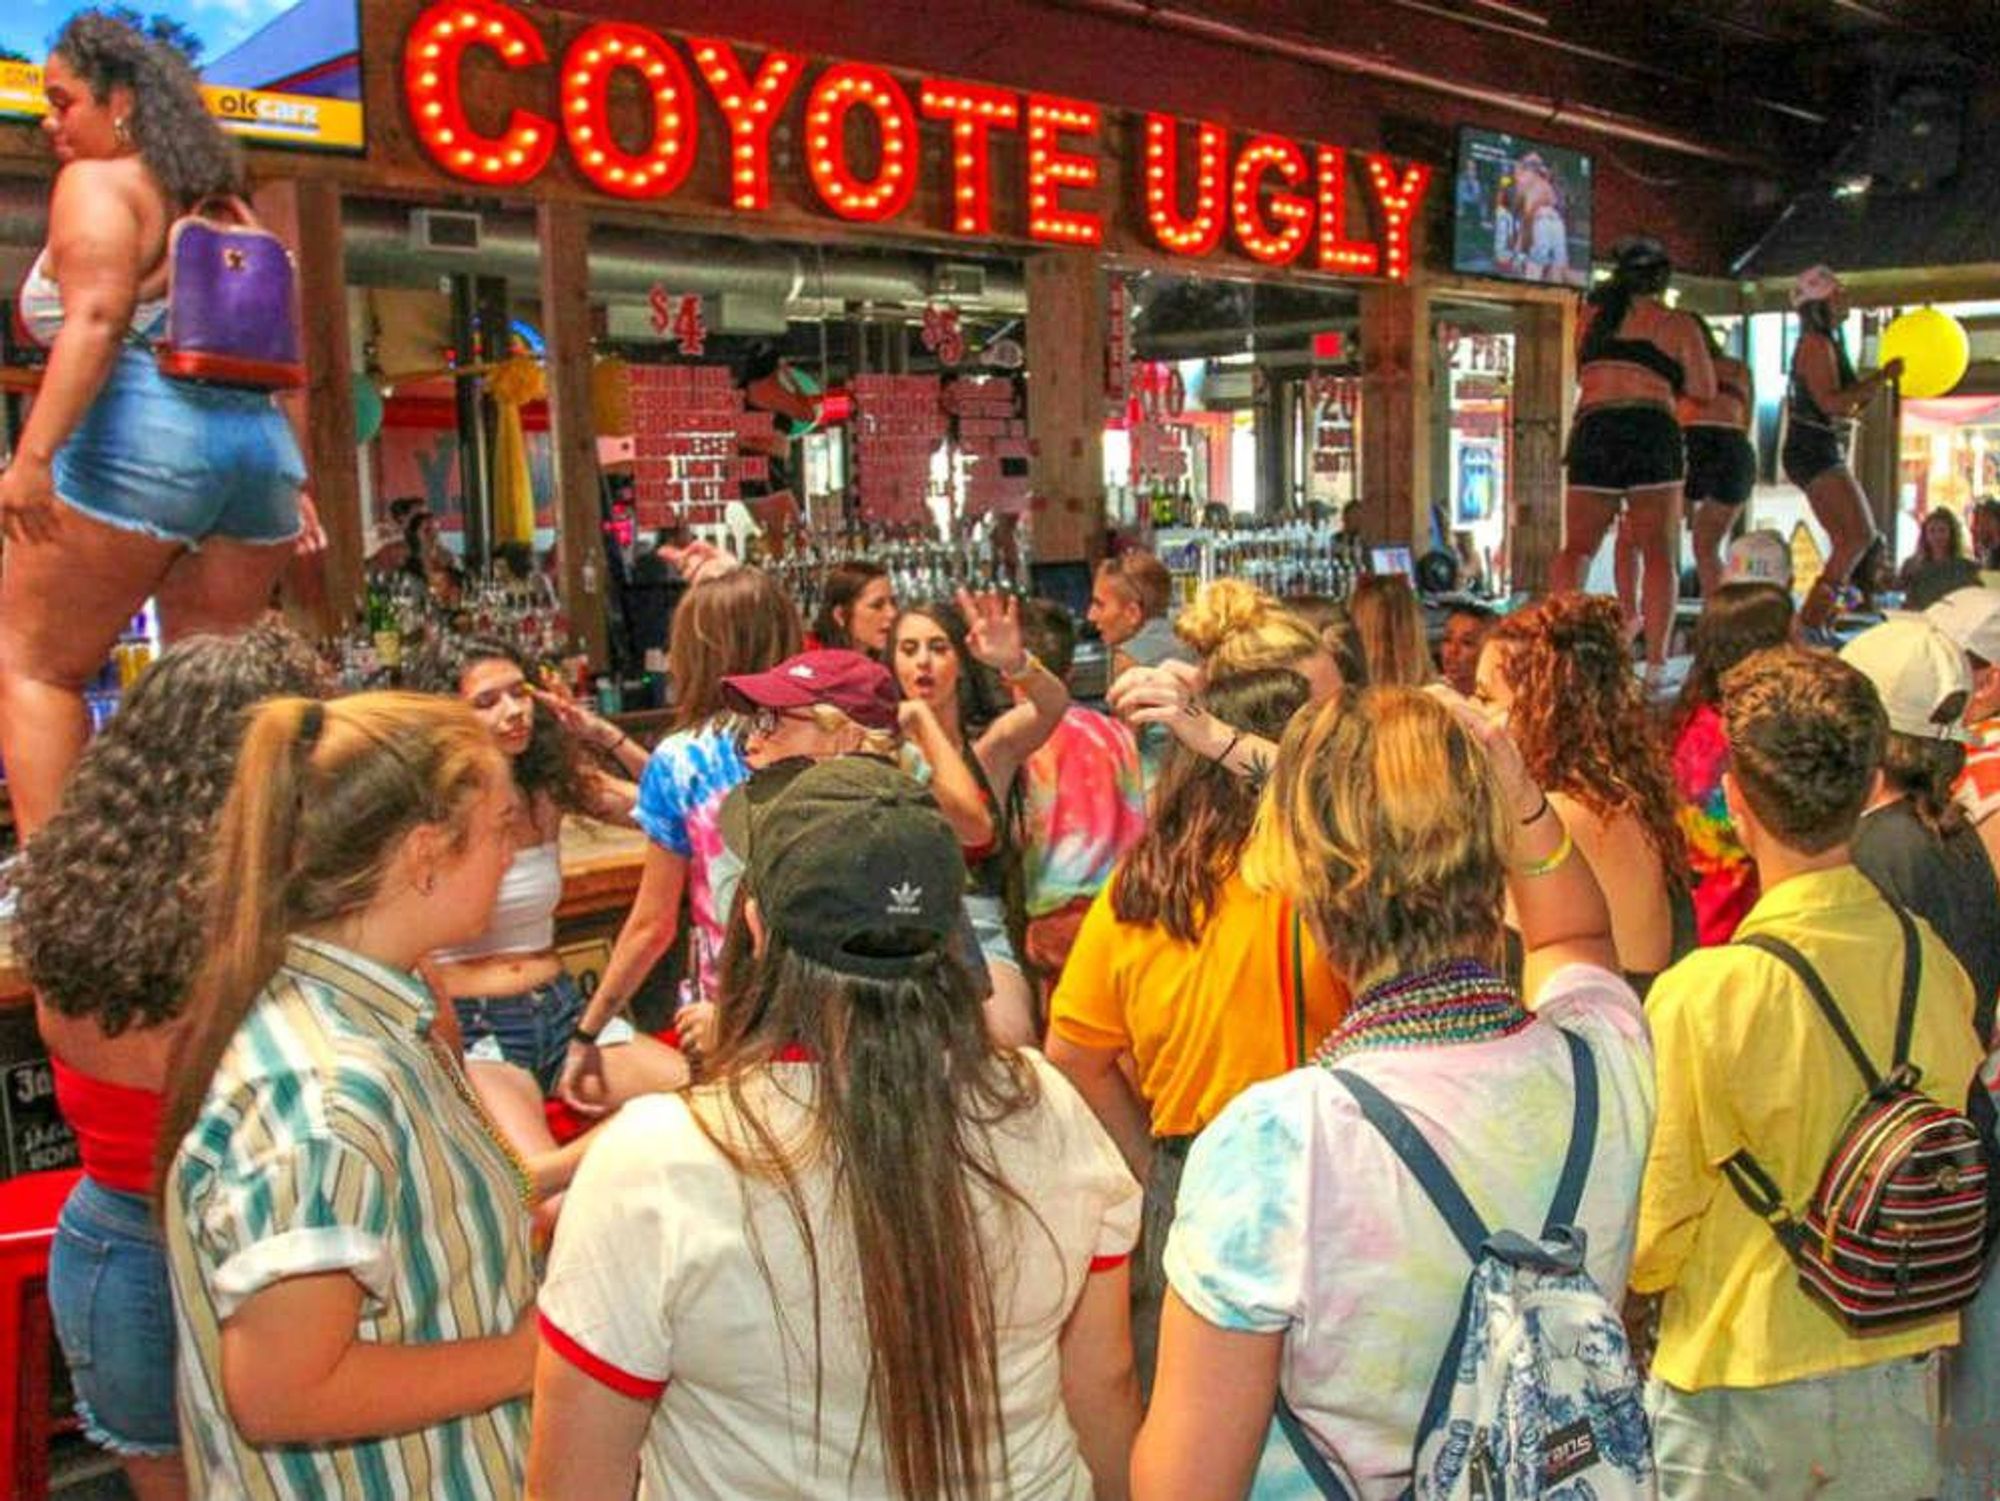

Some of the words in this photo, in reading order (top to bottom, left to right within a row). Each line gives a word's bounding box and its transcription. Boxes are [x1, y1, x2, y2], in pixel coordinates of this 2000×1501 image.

[404, 0, 1101, 246] COYOTE
[1146, 110, 1432, 285] UGLY
[648, 282, 706, 355] $4
